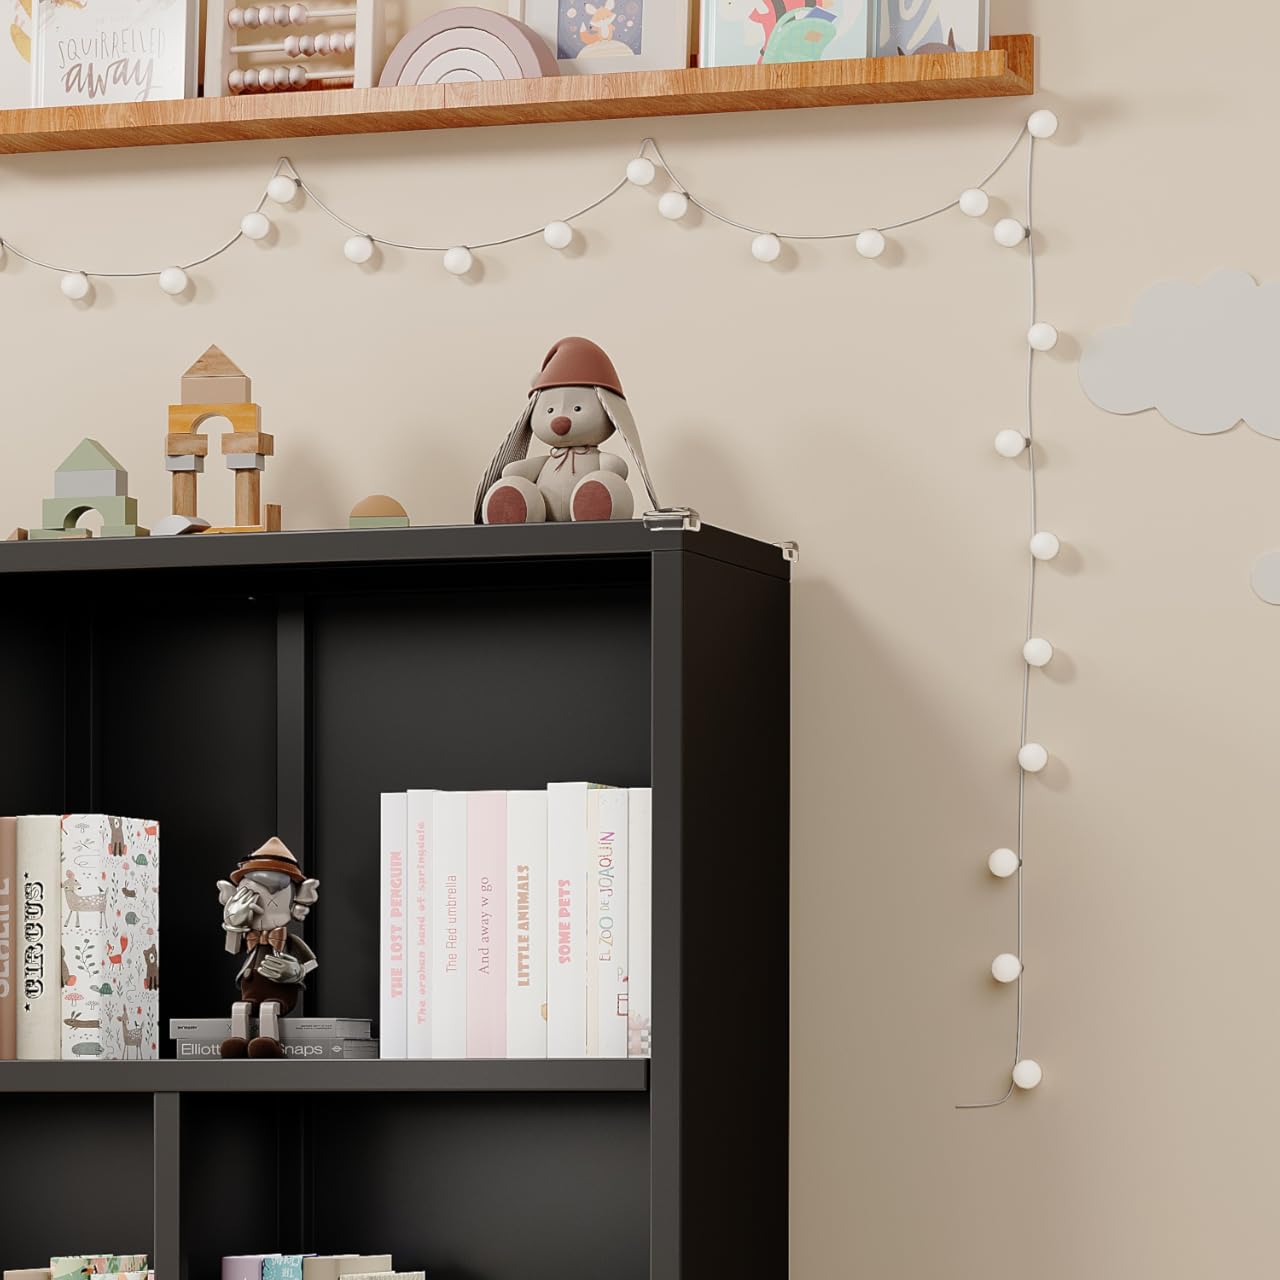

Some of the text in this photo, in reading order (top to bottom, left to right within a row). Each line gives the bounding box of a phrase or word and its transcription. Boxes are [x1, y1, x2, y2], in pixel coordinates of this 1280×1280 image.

[61, 58, 155, 102] away
[445, 875, 457, 924] umbrella
[481, 876, 493, 892] go
[23, 881, 44, 1000] CIRCUS
[390, 852, 403, 999] THE LOST PENGUIN
[446, 928, 458, 949] Red
[481, 911, 493, 943] away
[517, 865, 529, 987] LITTLE ANIMALS
[558, 879, 571, 965] SOME PETS
[598, 916, 614, 947] ZOO
[477, 948, 490, 975] And
[181, 1043, 222, 1056] Elliott
